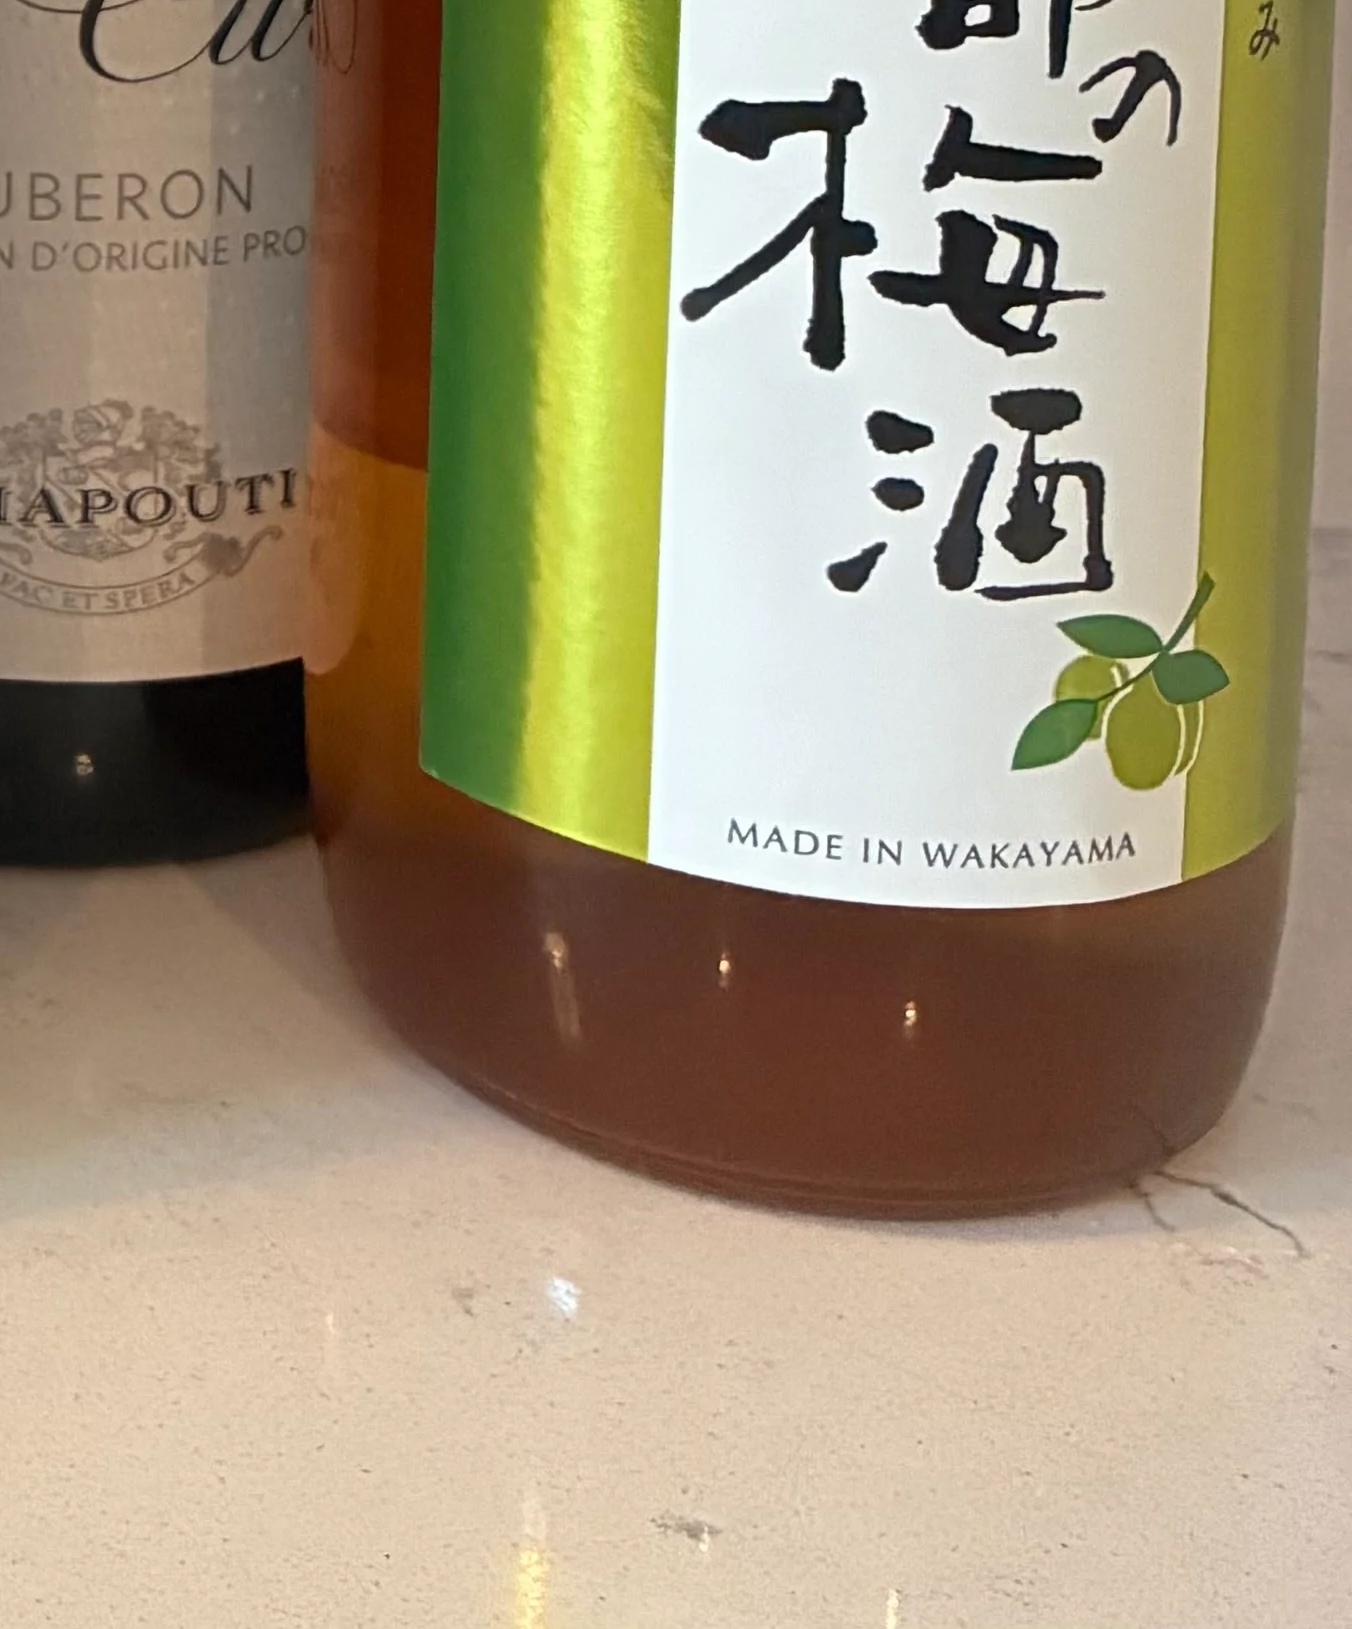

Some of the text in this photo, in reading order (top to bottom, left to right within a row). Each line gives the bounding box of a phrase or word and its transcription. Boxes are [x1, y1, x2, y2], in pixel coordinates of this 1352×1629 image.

[31, 235, 231, 273] D'ORIGINE
[62, 591, 98, 610] ET
[107, 570, 196, 611] SPERA
[727, 818, 1137, 870] MADE IN WAKAYAMA
